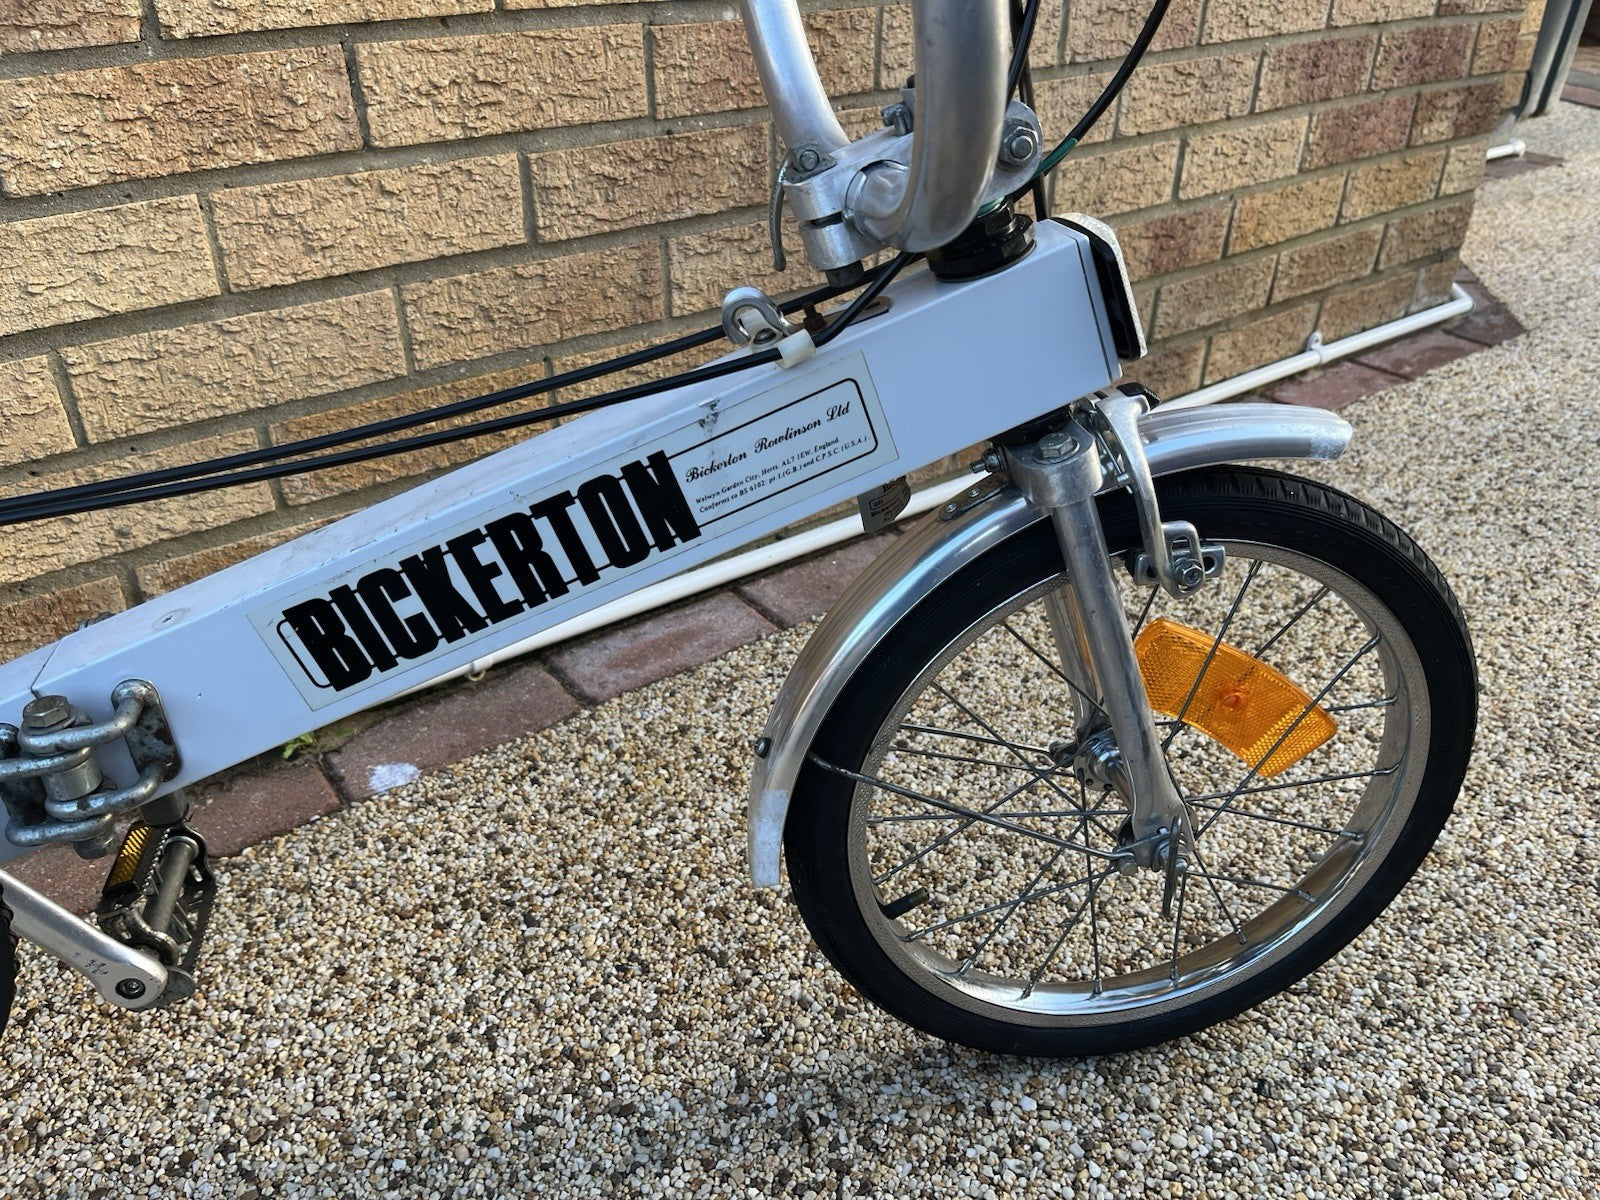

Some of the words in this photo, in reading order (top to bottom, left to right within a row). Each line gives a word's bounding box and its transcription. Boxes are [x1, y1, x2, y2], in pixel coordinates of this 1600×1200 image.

[685, 453, 747, 483] Bickerton
[754, 419, 821, 453] Rowlinson
[826, 401, 850, 422] Ltd
[695, 489, 720, 504] Welwyn
[721, 480, 744, 493] Garden
[699, 497, 730, 513] Conforms
[739, 487, 748, 496] BS
[803, 458, 815, 468] and
[282, 450, 702, 692] BICKERTON
